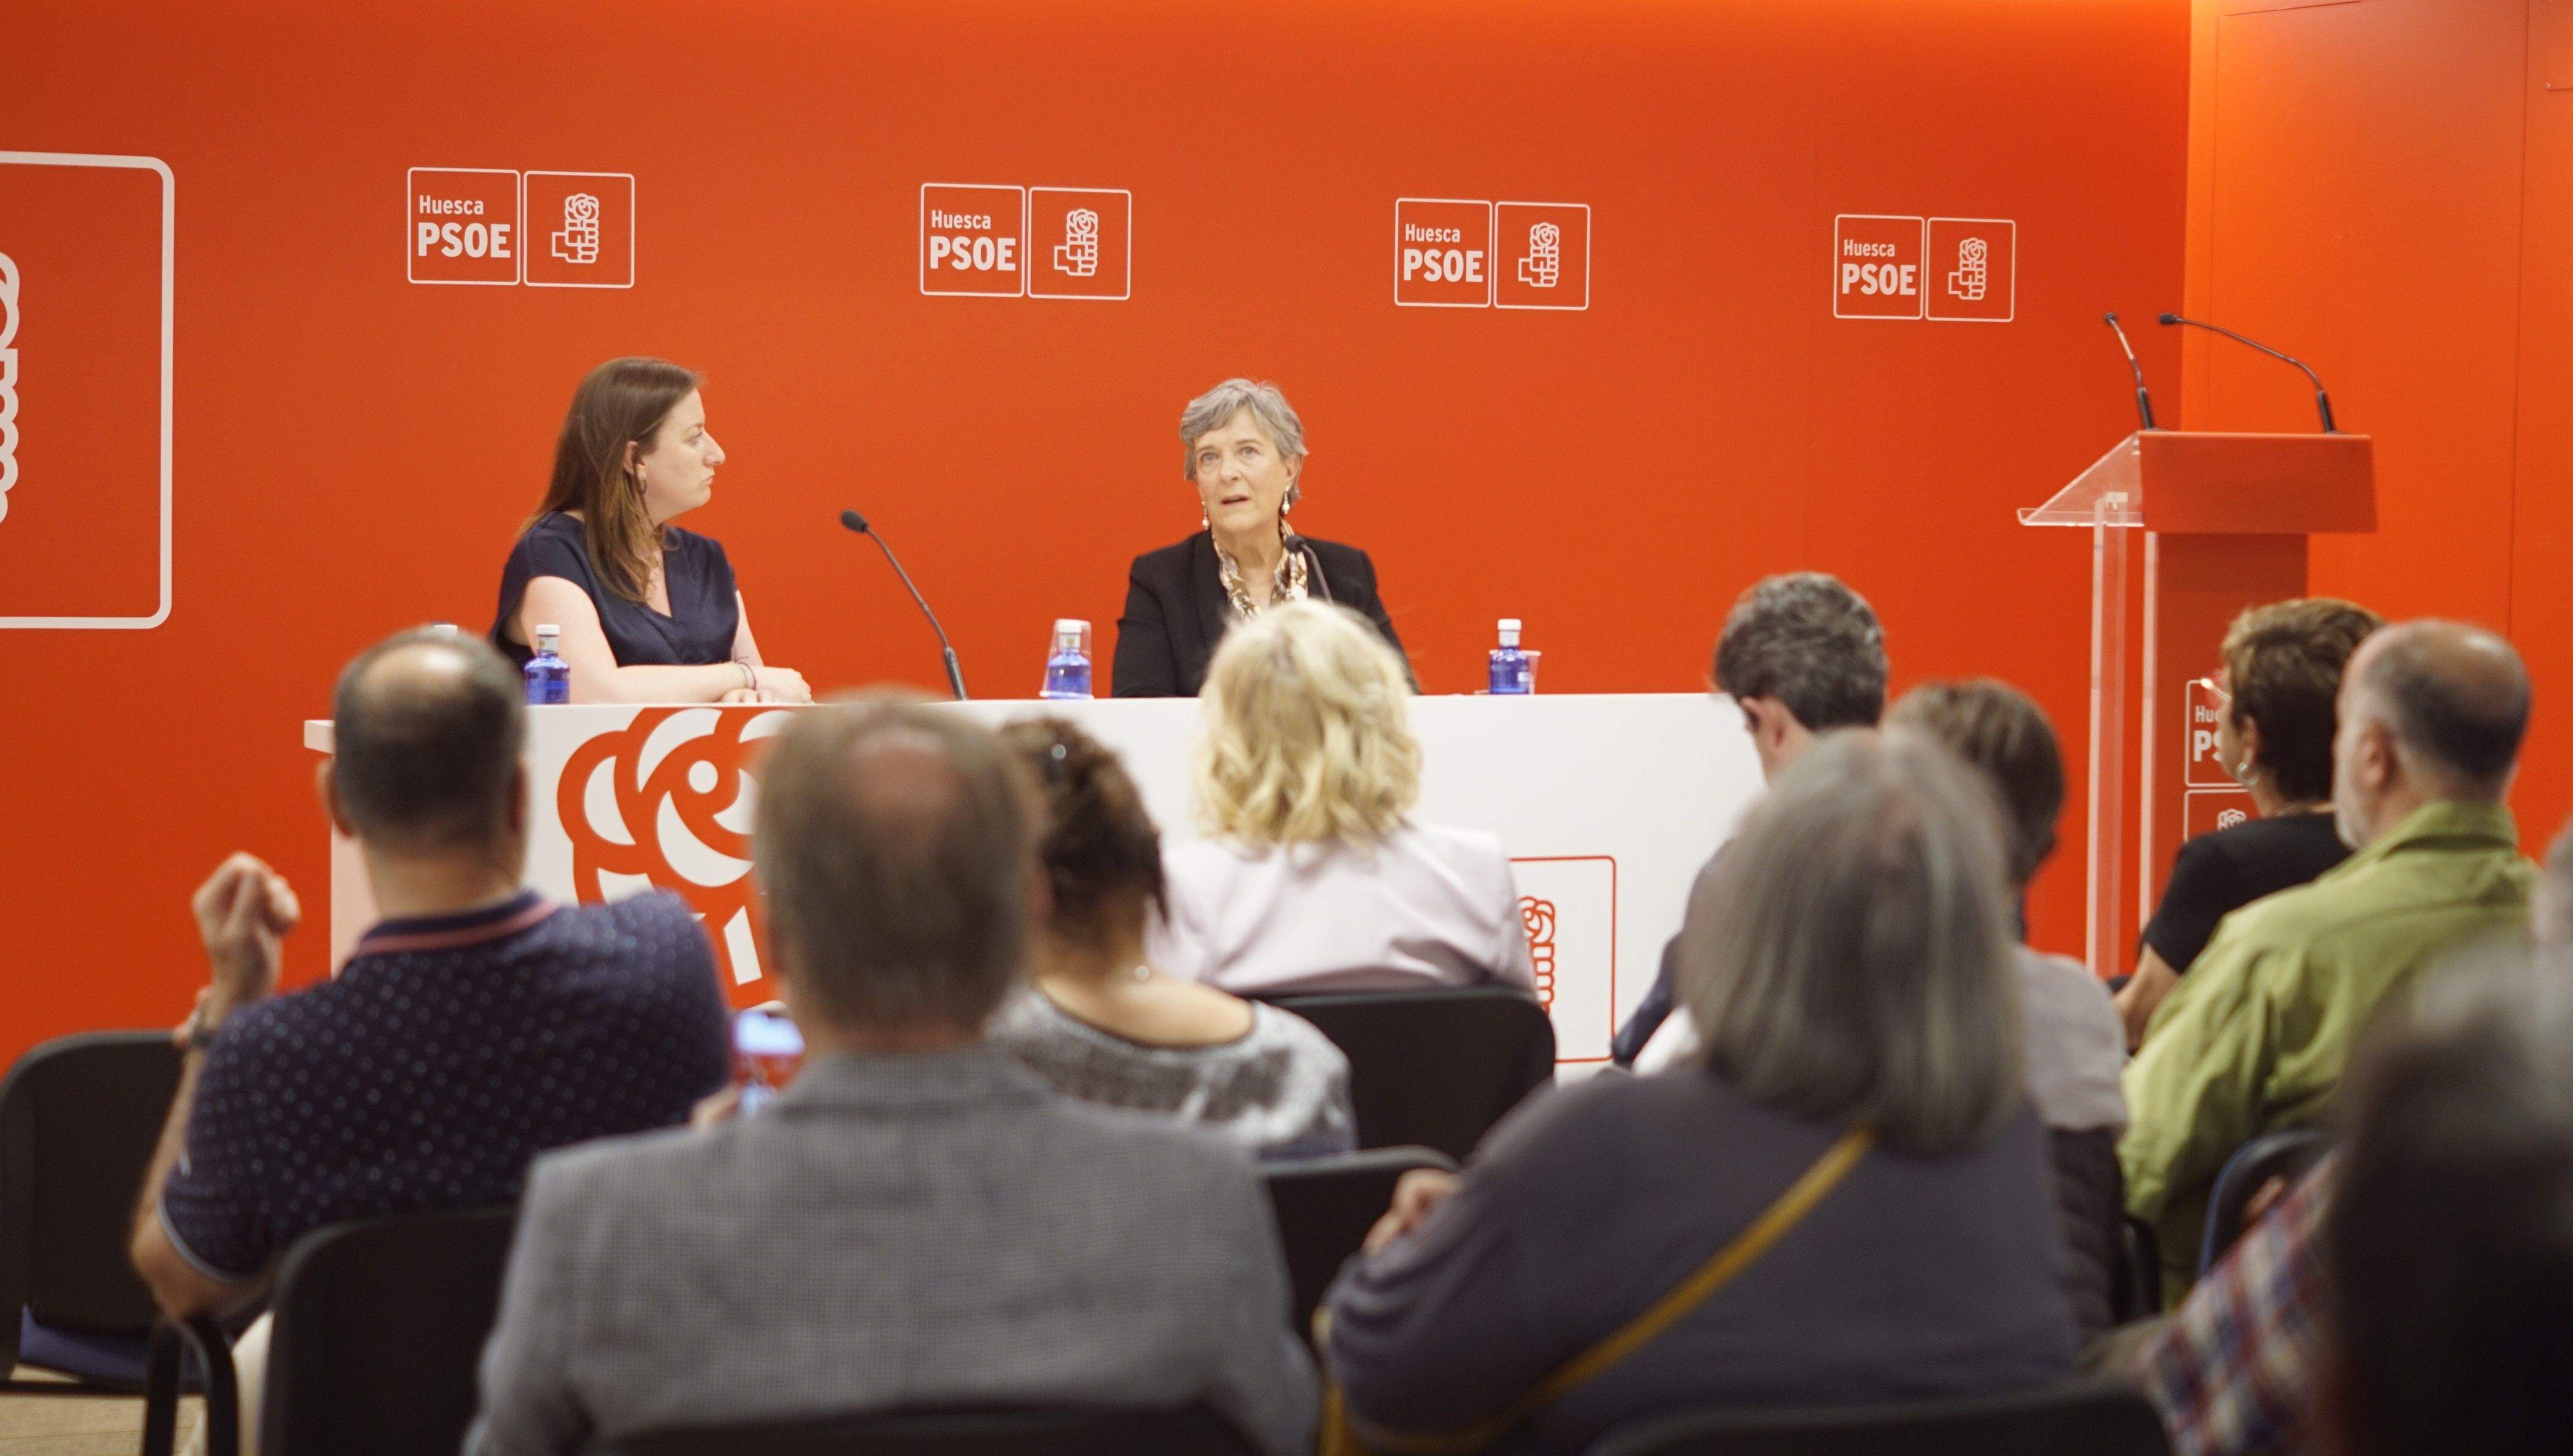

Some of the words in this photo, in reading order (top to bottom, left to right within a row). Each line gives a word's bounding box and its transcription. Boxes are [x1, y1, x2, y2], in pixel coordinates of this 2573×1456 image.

[419, 195, 484, 215] Huesca
[931, 209, 992, 230] Huesca
[418, 222, 511, 259] PSOE
[1405, 223, 1461, 243] Huesca
[1844, 239, 1895, 257] Huesca
[930, 235, 1016, 271] PSOE
[1403, 248, 1484, 283] PSOE
[1842, 263, 1916, 295] PSOE
[2193, 730, 2223, 762] PS
